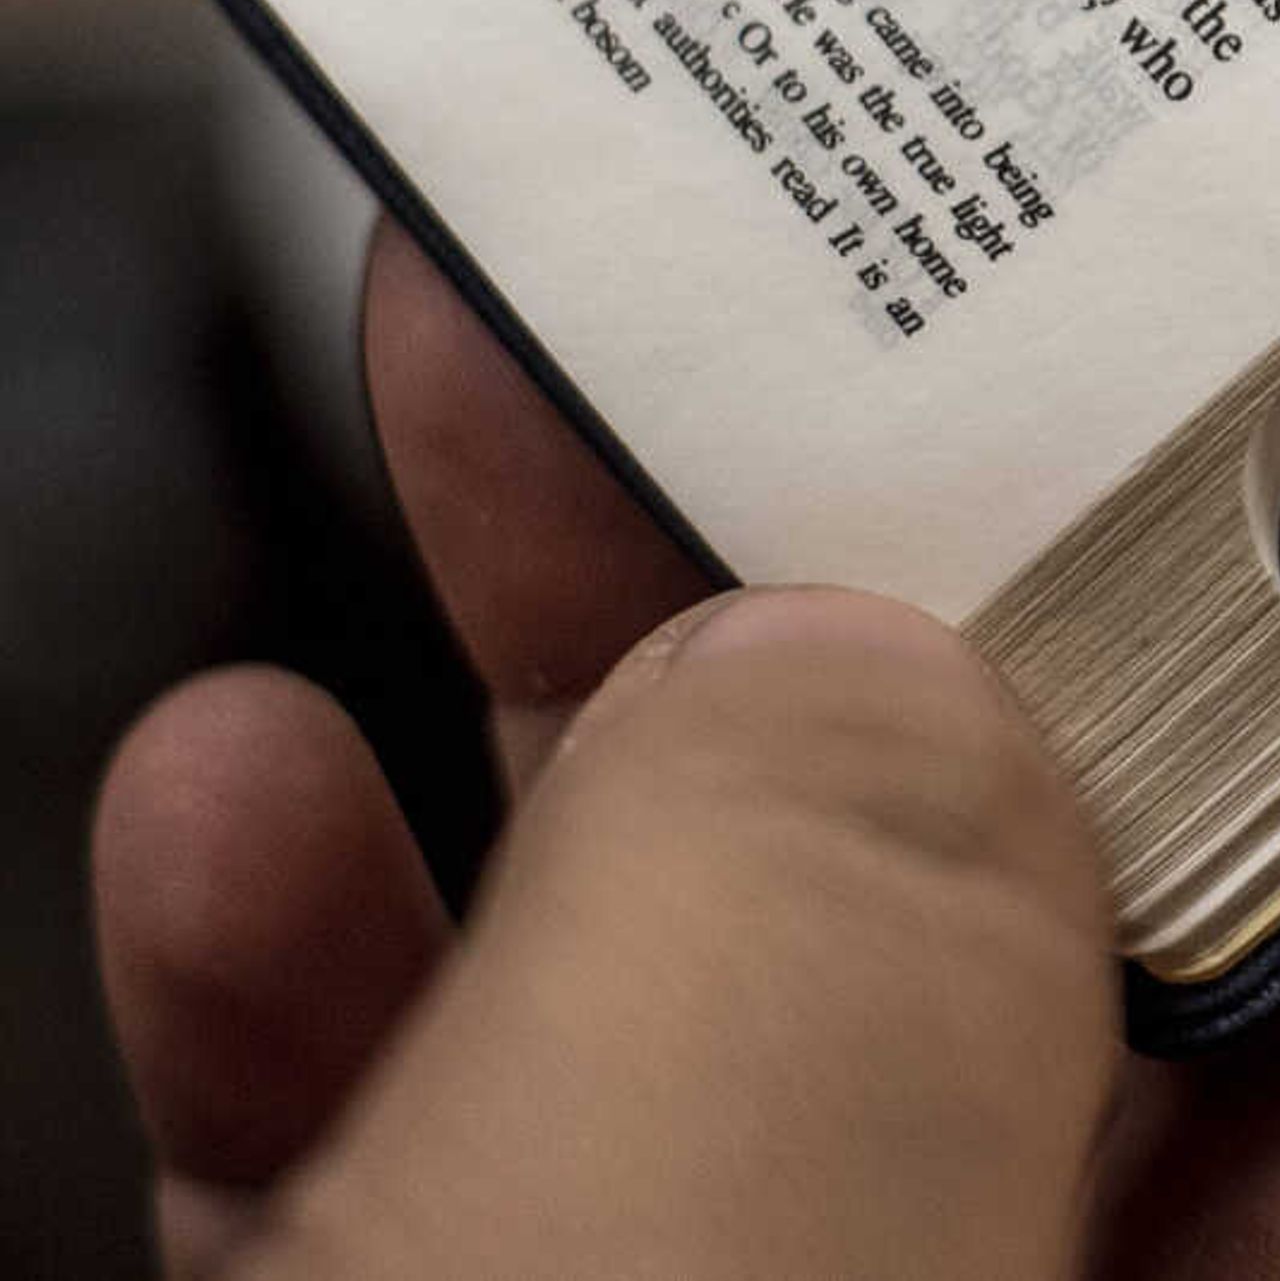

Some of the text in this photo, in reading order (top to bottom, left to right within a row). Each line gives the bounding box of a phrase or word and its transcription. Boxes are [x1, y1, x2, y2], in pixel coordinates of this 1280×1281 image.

[651, 12, 774, 154] authorities
[769, 155, 840, 224] read
[827, 221, 865, 258] It
[855, 257, 889, 291] is
[884, 296, 925, 338] an
[736, 20, 968, 299] Or to his own home
[812, 28, 865, 85] was
[857, 83, 905, 133] the
[899, 134, 956, 196] true
[949, 192, 1015, 262] light
[864, 5, 935, 81] came
[928, 79, 985, 141] into
[981, 139, 1055, 229] being
[1119, 15, 1194, 102] who
